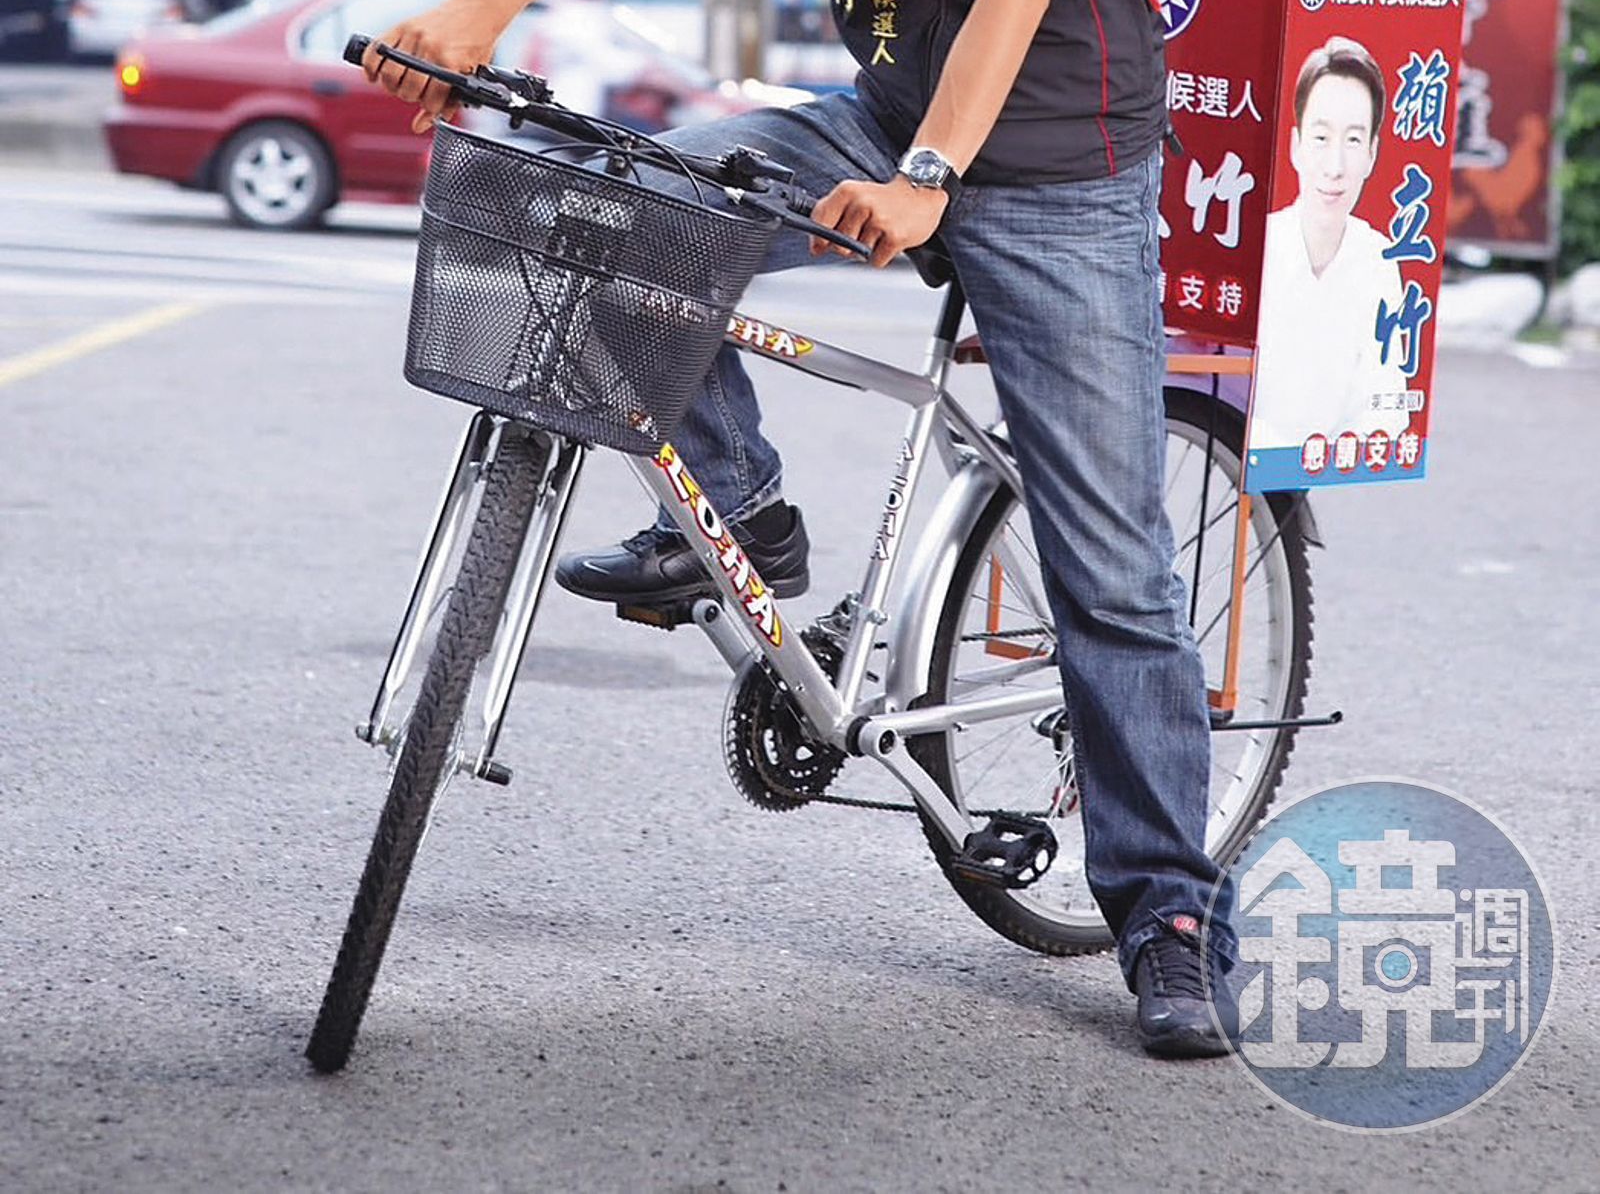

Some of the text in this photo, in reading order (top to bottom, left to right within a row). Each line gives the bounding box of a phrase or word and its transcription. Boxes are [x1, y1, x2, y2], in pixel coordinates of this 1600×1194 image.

[1158, 150, 1255, 249] 竹
[1374, 49, 1450, 379] 賴立竹
[1159, 271, 1243, 316] 支持
[662, 450, 775, 637] LOHA
